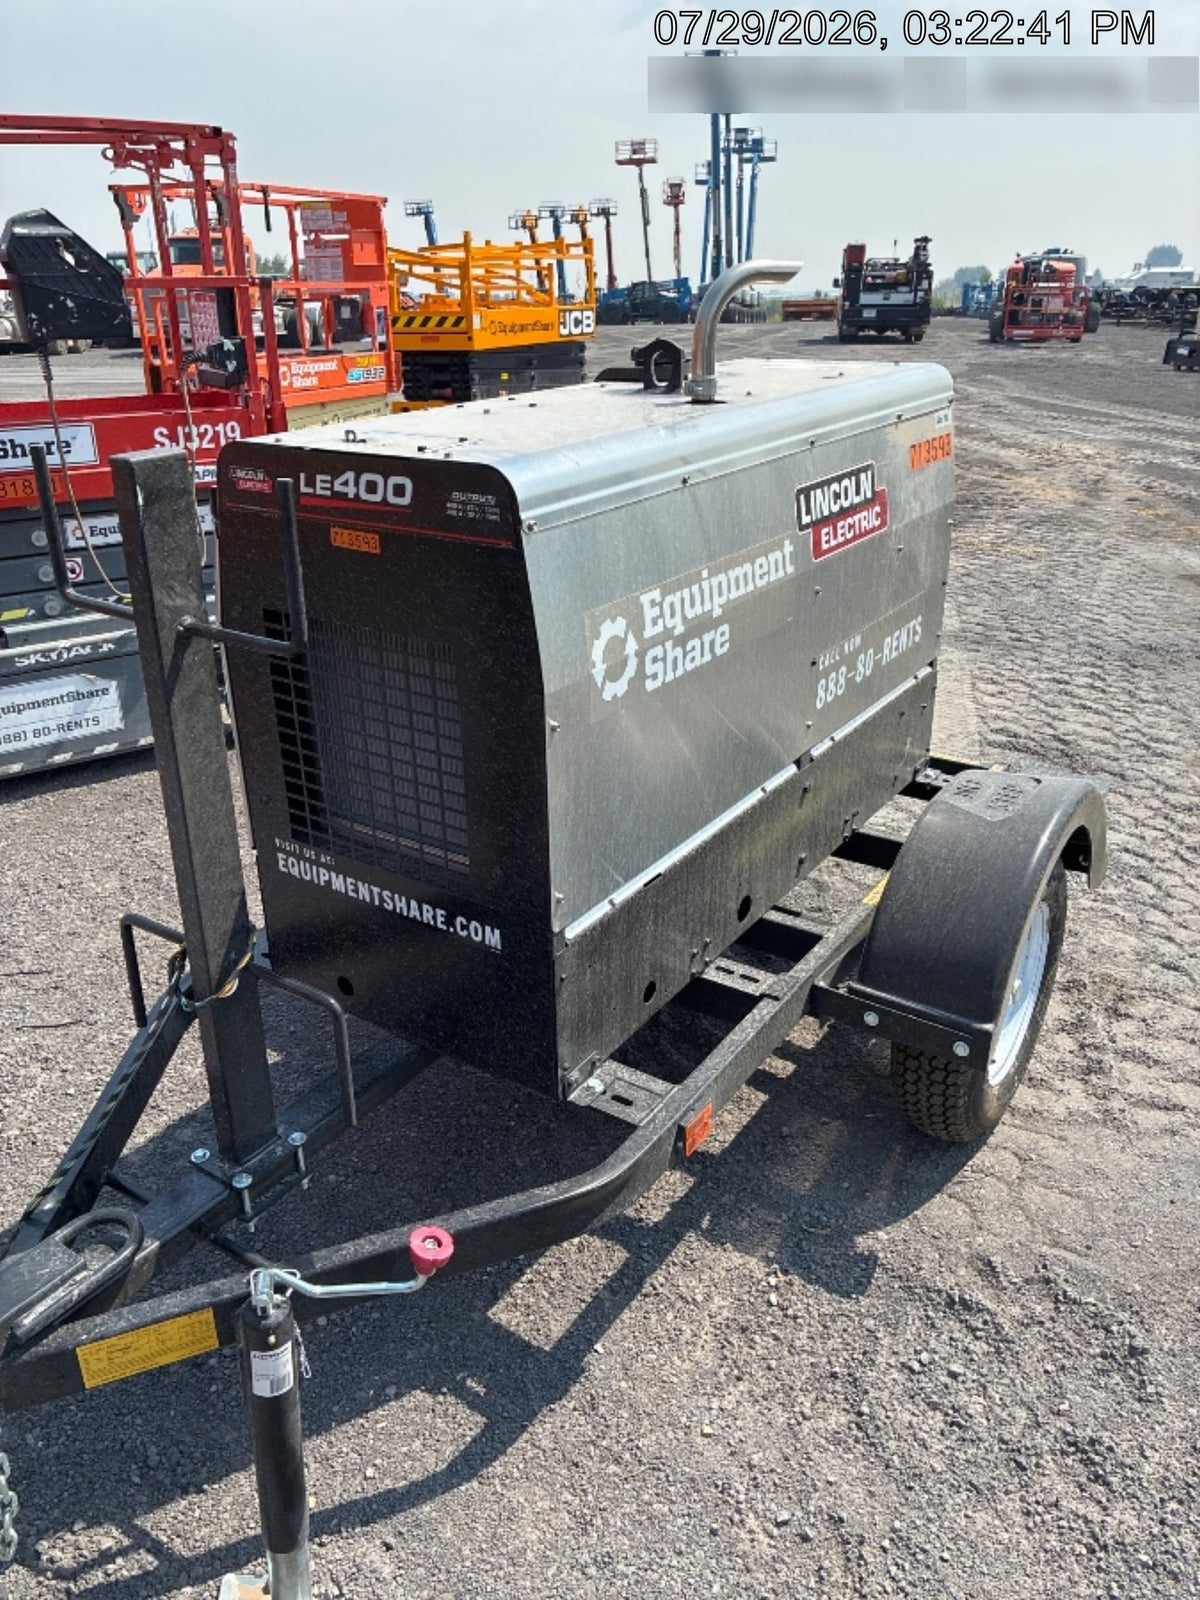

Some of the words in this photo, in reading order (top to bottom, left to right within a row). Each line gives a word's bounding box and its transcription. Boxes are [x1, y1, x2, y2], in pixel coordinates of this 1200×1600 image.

[560, 311, 595, 336] JCB
[154, 421, 241, 452] SJ3219
[300, 471, 413, 505] LE400
[800, 471, 872, 524] LINCOLN
[821, 506, 881, 551] ELECTRIC
[640, 540, 794, 636] Equipment
[645, 623, 730, 692] Share
[816, 615, 922, 710] 888-80-RENTS
[32, 716, 100, 739] 80-RENTS
[303, 848, 316, 859] US
[277, 852, 501, 950] EQUIPMENTSHARE.COM
